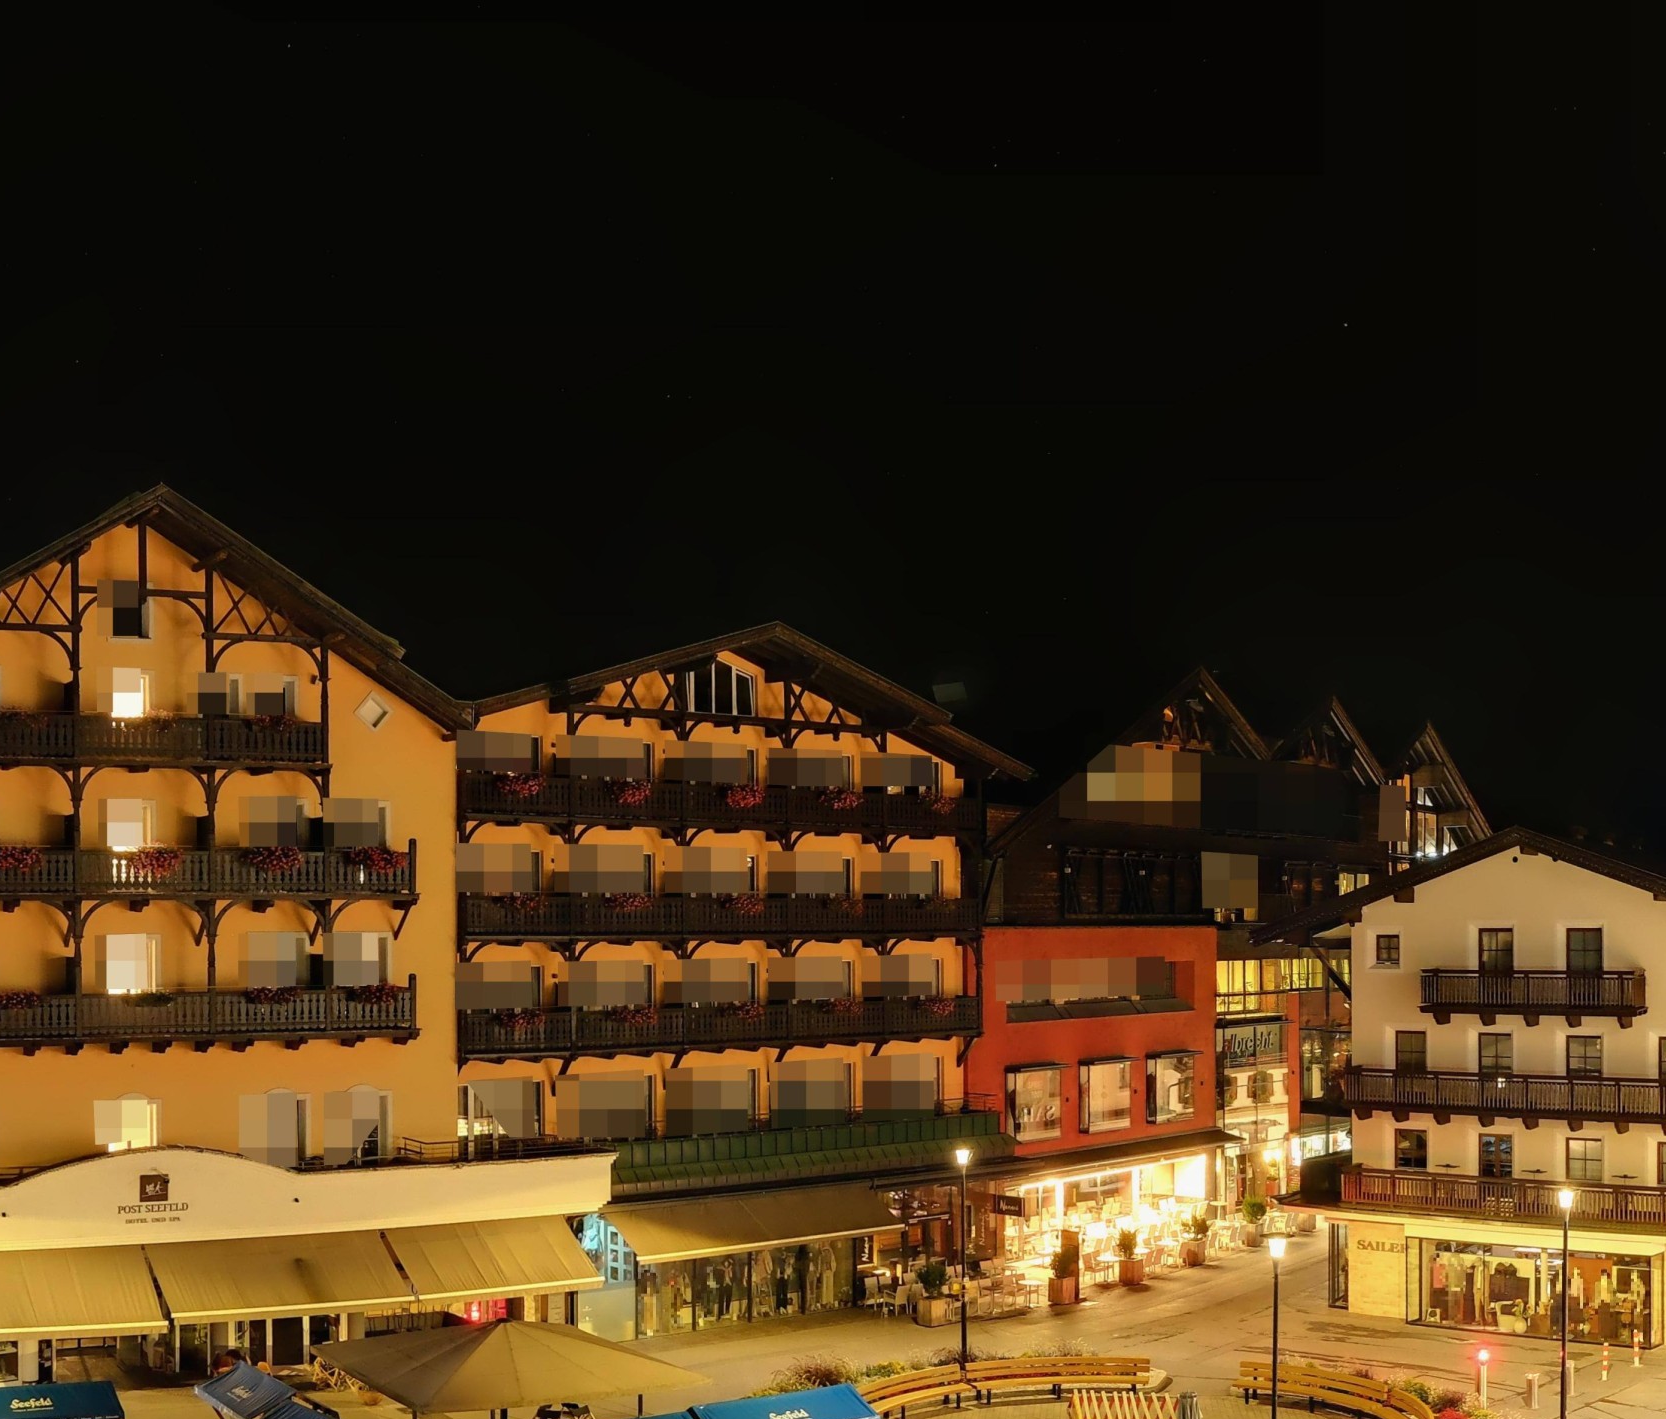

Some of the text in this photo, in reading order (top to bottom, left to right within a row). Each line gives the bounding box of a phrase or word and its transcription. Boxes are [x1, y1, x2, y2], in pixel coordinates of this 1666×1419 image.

[117, 1202, 189, 1214] POST SEEFELD
[10, 1397, 54, 1410] Seefeld
